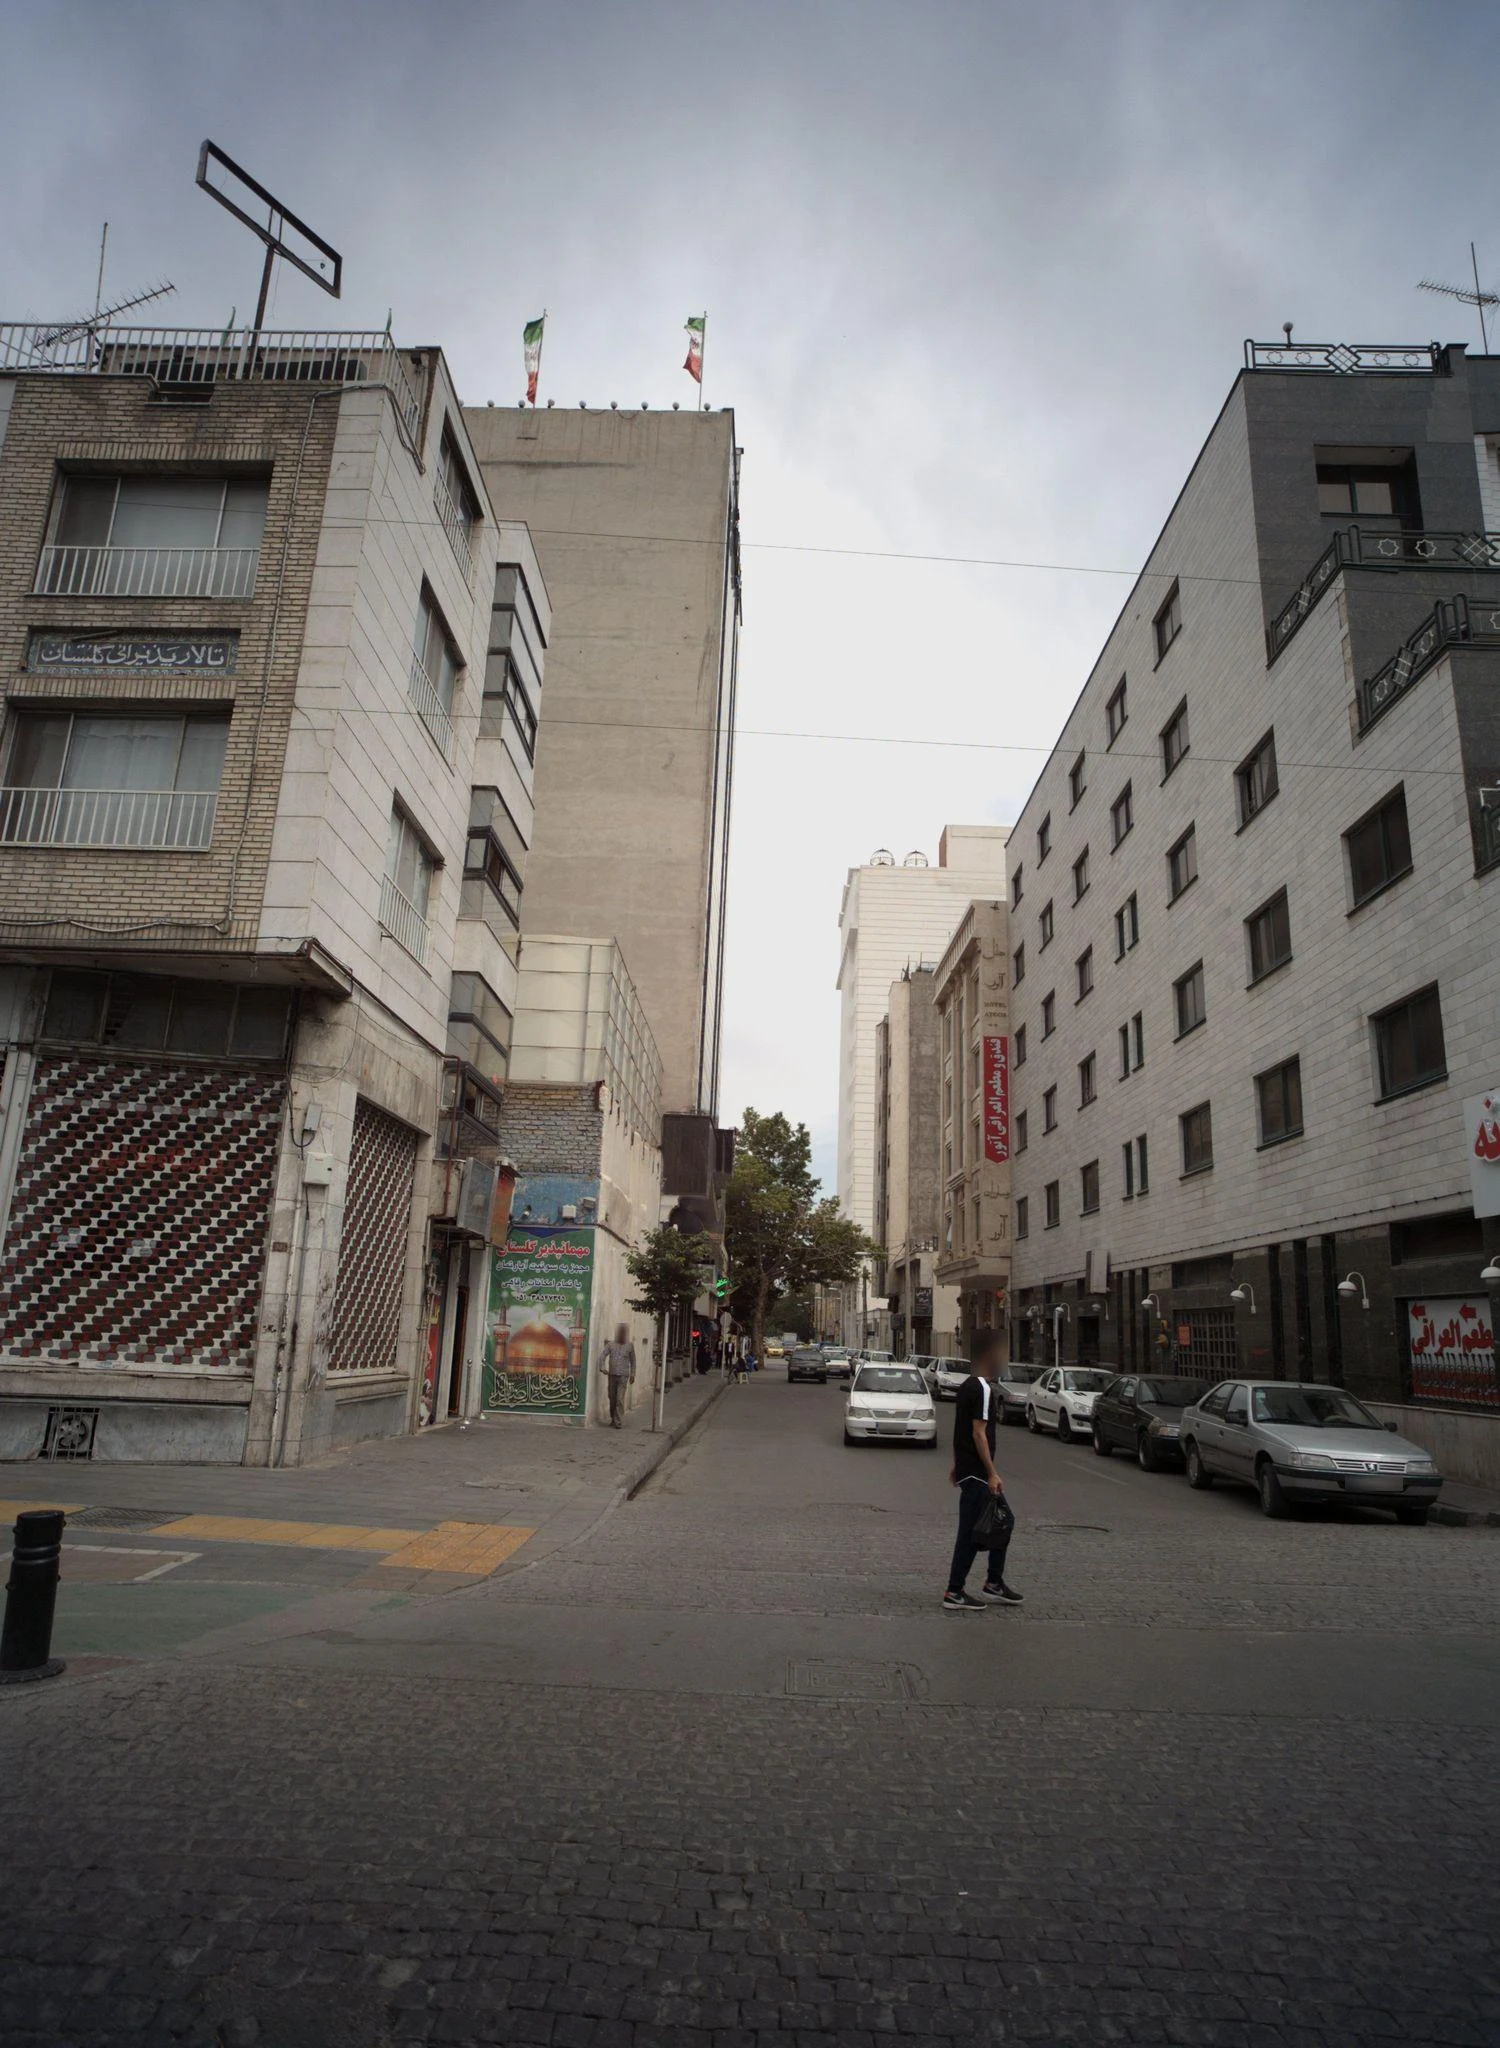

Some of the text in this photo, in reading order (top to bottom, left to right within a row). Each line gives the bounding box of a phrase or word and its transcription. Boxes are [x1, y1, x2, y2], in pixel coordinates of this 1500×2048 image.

[41, 642, 115, 663] گلستان
[176, 645, 225, 666] تالار
[986, 1038, 1006, 1063] فندق
[988, 1071, 1006, 1096] مطعم
[559, 1263, 569, 1274] به
[568, 1263, 590, 1274] مجهز
